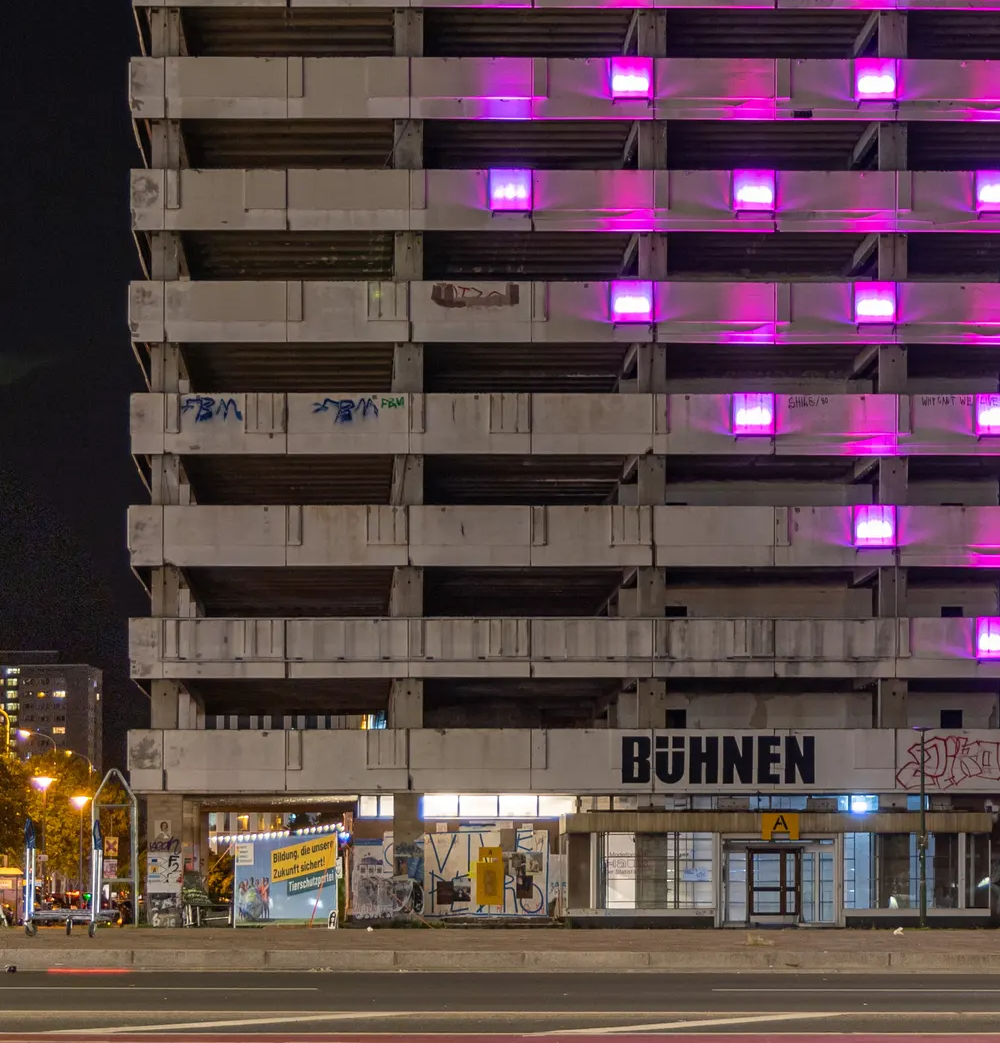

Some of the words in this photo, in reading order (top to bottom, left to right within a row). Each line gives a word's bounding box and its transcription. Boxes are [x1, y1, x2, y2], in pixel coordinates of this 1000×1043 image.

[622, 735, 815, 785] BÜHNEN
[773, 815, 788, 831] A
[273, 851, 299, 864] Bildung,
[301, 846, 311, 856] die
[312, 840, 334, 853] unsere
[273, 864, 299, 878] Zukunft
[301, 856, 325, 872] sichert!
